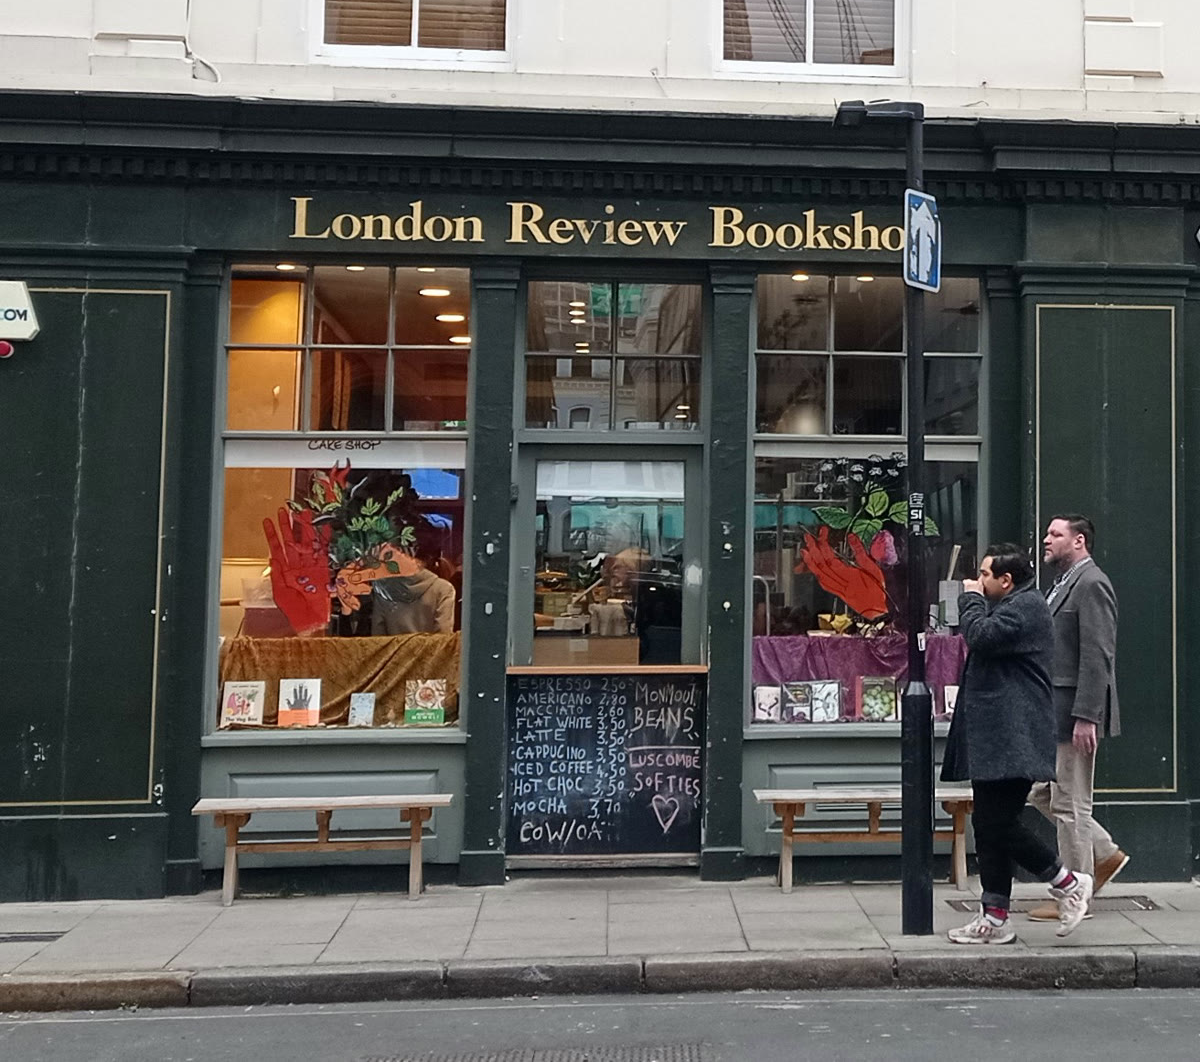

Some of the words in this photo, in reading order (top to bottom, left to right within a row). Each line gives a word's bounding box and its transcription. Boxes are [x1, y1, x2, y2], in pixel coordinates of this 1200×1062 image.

[290, 197, 485, 242] London
[505, 202, 687, 246] Review
[708, 206, 904, 251] Booksho
[345, 440, 381, 450] SHOP
[518, 678, 591, 693] ESPRESSO
[517, 692, 592, 706] AMERICANO
[635, 681, 700, 707] MONMOUT
[515, 704, 583, 717] MACCIATO
[516, 716, 552, 729] FLAT
[556, 716, 592, 729] WHITE
[630, 707, 694, 732] BEANS
[515, 728, 566, 743] LATTE
[516, 744, 586, 760] CAPPUCINO
[514, 762, 543, 776] ICED
[549, 760, 594, 774] COFFEE
[629, 752, 701, 769] LUSCOMBE
[513, 778, 542, 796] HOT
[547, 776, 584, 797] CHOC
[633, 772, 700, 798] SOFTIES
[513, 797, 567, 817] MOCHA
